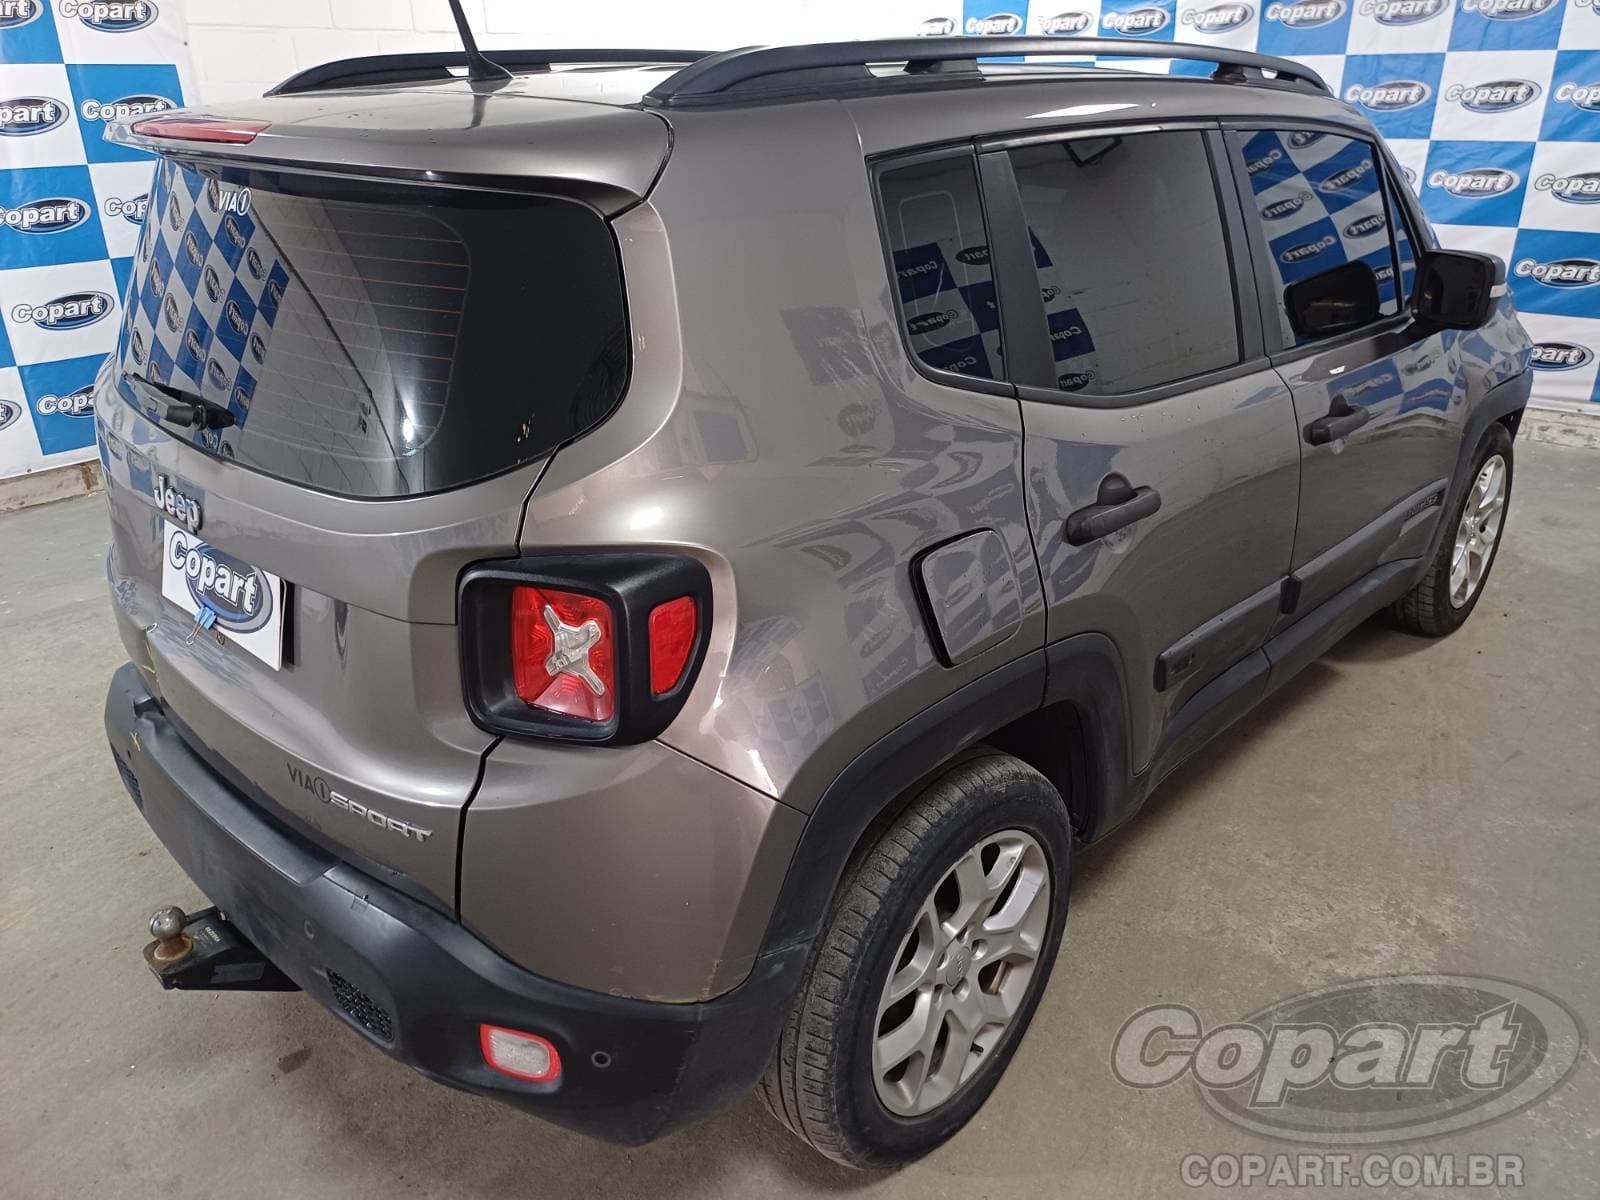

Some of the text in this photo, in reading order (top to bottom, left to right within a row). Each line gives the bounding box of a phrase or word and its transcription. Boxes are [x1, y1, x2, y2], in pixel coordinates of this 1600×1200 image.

[59, 0, 145, 24] Copart
[1102, 10, 1162, 33] Copart
[1182, 6, 1243, 26] Copart
[1264, 0, 1339, 24] Copart
[1359, 0, 1434, 19] Copart
[1345, 83, 1421, 107] Copart
[1445, 83, 1529, 105] Copart
[1553, 81, 1600, 107] Cop
[0, 101, 56, 128] part
[1426, 169, 1510, 193] Copart
[1534, 173, 1600, 197] Copa
[104, 197, 148, 219] Cop
[12, 293, 102, 324] Copart
[1532, 345, 1582, 365] part
[153, 474, 202, 535] Jeep
[169, 530, 258, 617] Copart
[330, 790, 432, 842] SPORT
